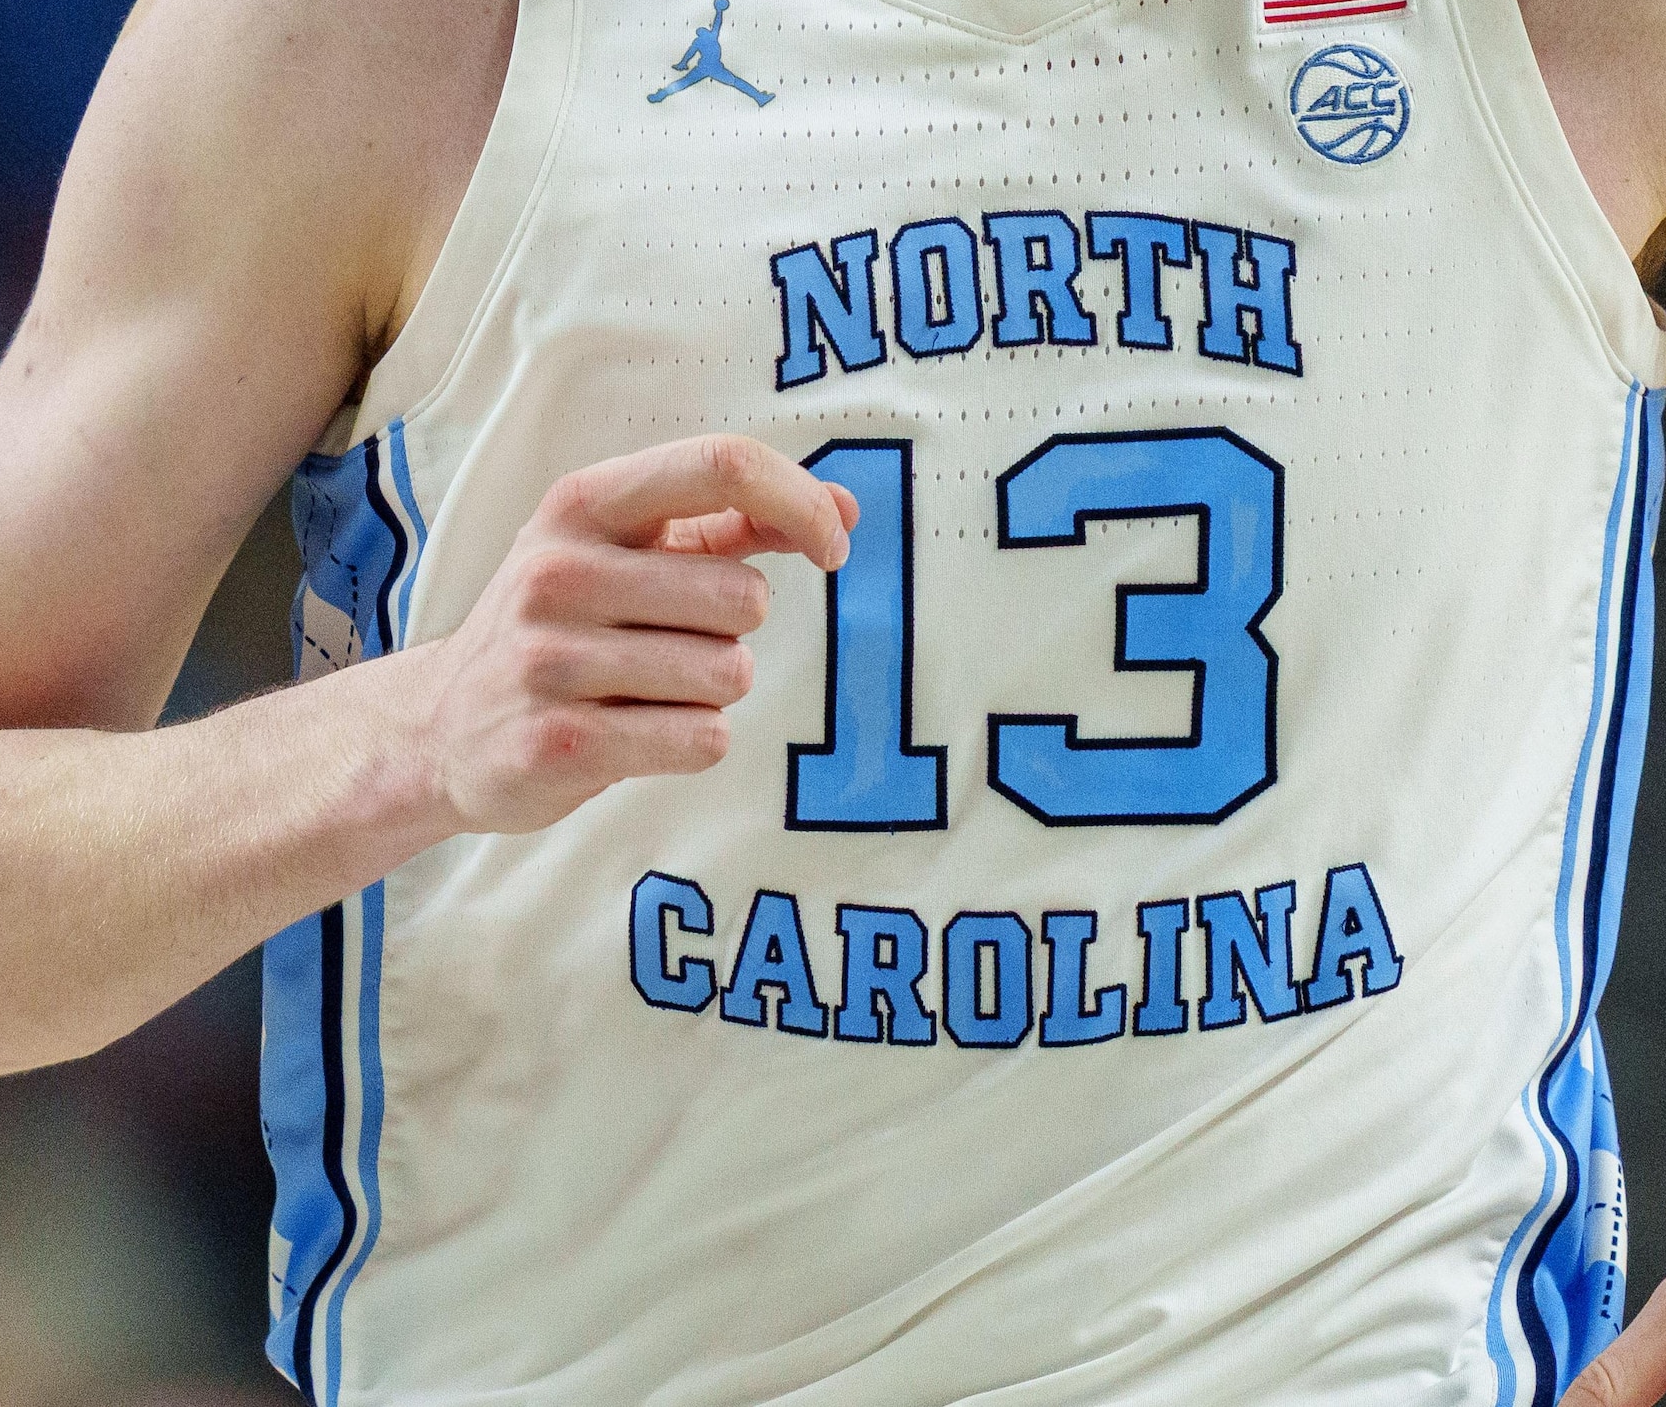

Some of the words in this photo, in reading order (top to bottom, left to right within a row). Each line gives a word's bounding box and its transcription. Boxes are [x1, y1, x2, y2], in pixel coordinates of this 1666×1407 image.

[1307, 80, 1400, 112] ACC
[770, 209, 1303, 392] NORTH
[784, 426, 1286, 832] 13
[629, 862, 1404, 1049] CAROLINA
